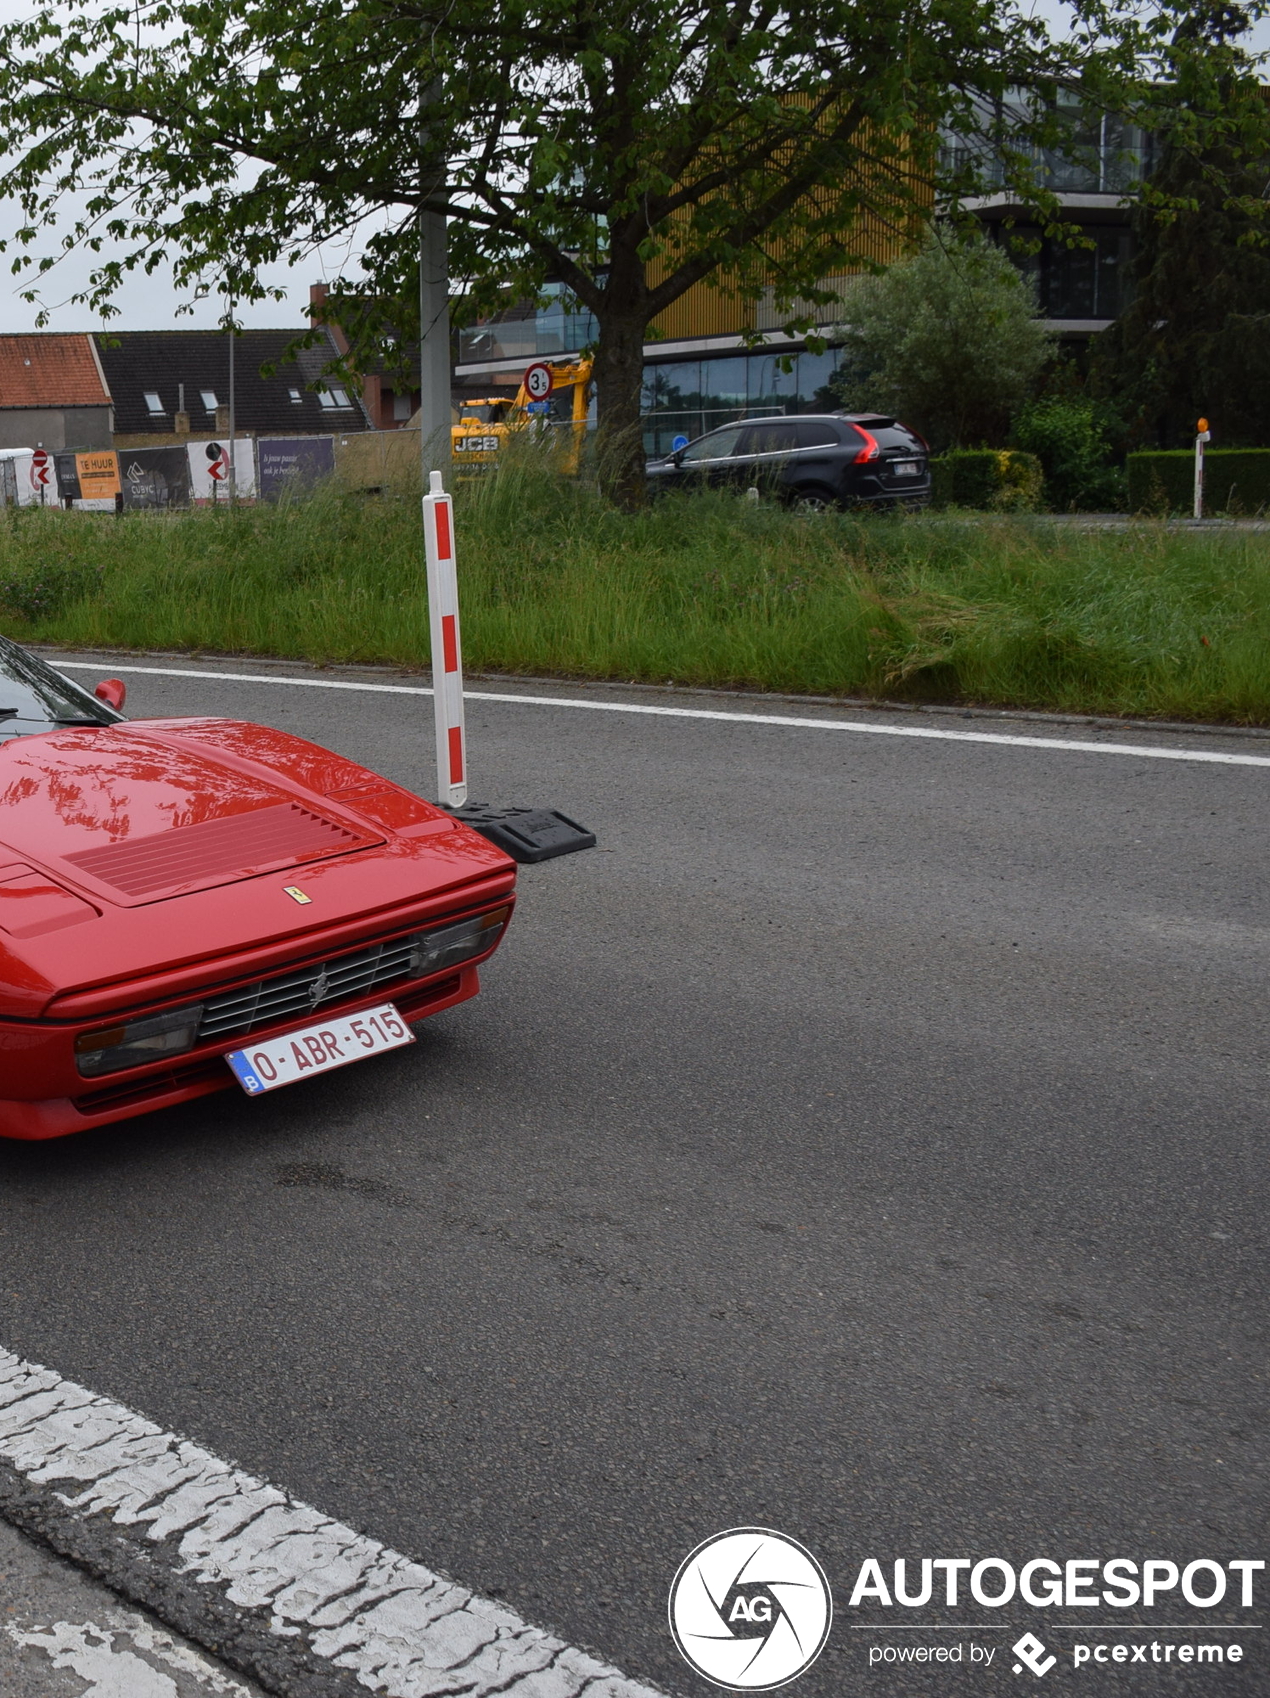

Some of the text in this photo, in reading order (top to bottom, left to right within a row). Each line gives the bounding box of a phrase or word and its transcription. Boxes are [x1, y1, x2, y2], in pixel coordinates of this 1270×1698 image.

[530, 373, 540, 391] 3
[541, 381, 547, 391] 5
[455, 436, 499, 452] JCB
[80, 458, 114, 470] TE HUUR
[131, 484, 154, 495] CUBYC
[244, 1075, 260, 1090] B
